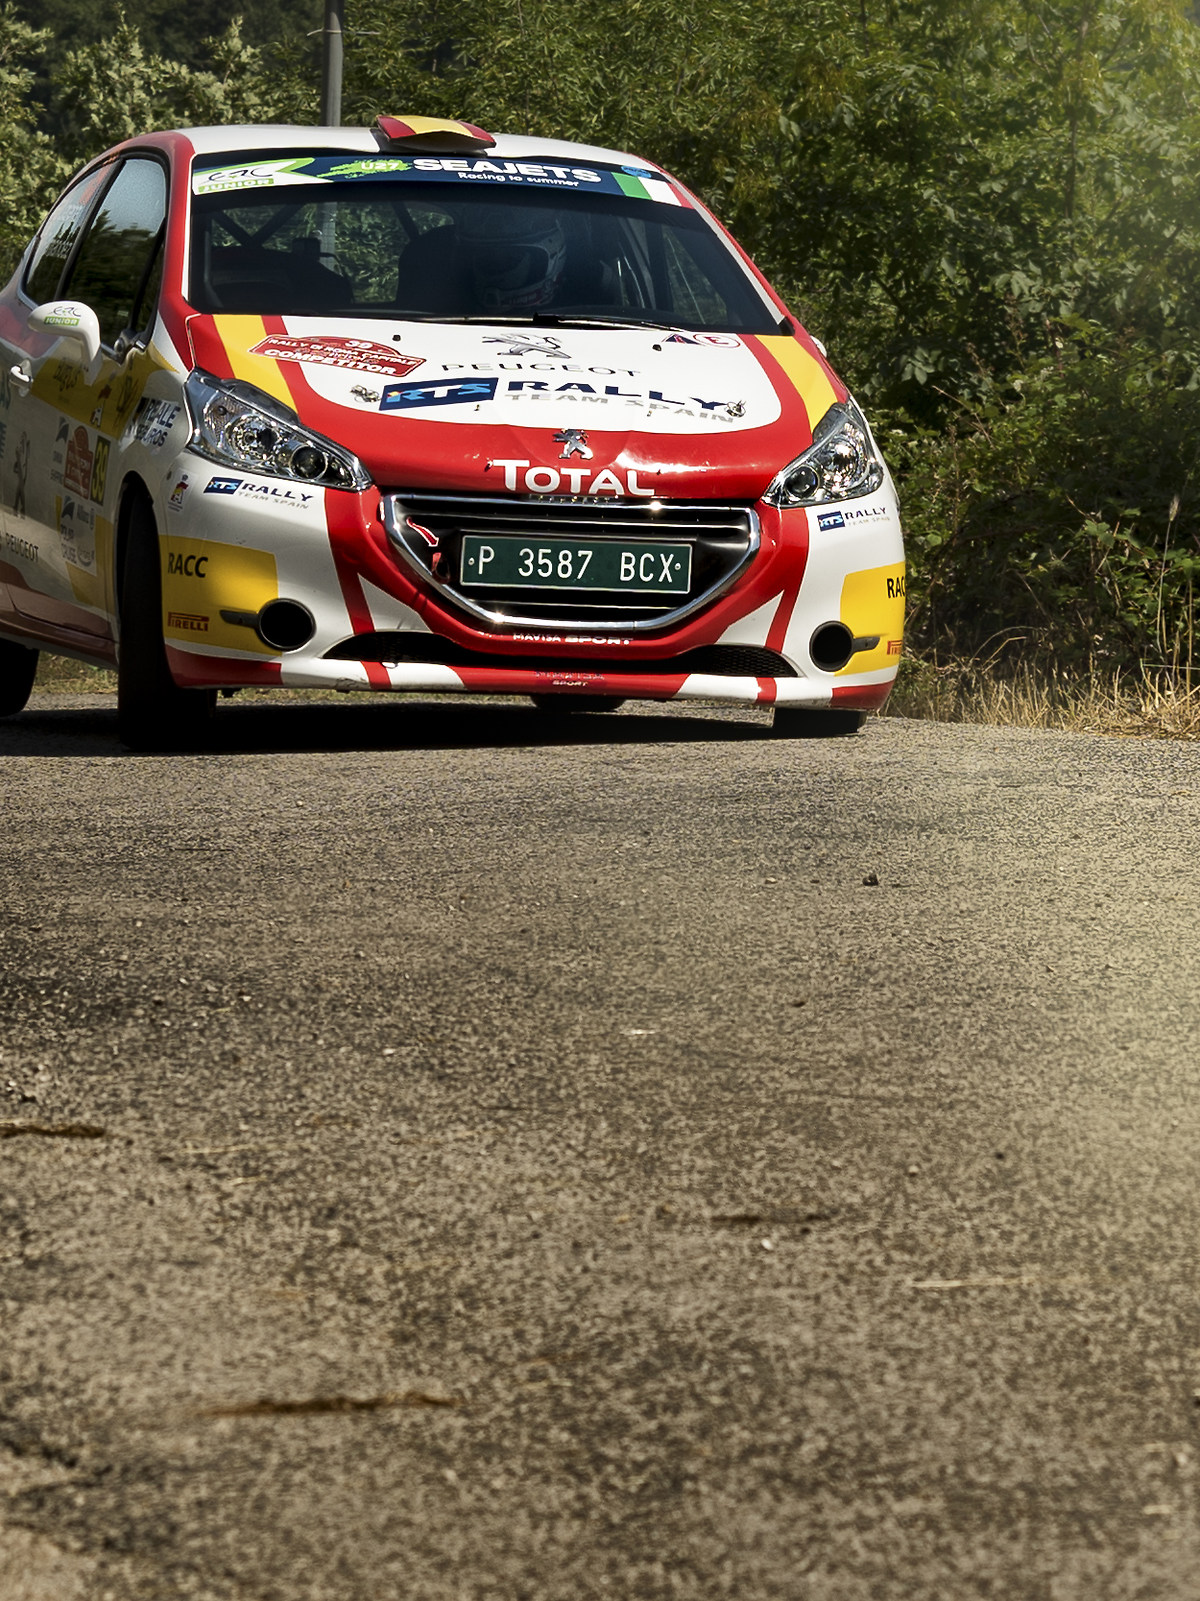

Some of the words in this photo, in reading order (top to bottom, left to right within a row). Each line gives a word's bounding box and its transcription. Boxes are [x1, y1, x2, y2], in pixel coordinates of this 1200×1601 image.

[360, 162, 399, 171] U27
[413, 159, 601, 183] SEAJETS
[201, 178, 273, 193] JUNIOR
[457, 172, 505, 182] Racing
[527, 177, 579, 187] summer
[45, 317, 78, 326] JUNIOR
[269, 338, 309, 348] RALLY
[358, 352, 418, 366] CAPITALE
[345, 340, 373, 350] 39
[264, 349, 397, 375] COMPETITOR
[441, 362, 641, 377] PEUGEOT
[386, 383, 492, 404] RTS
[507, 381, 731, 411] RALLY
[505, 393, 609, 406] TEAM
[624, 400, 734, 424] SPAIN
[91, 441, 109, 502] 39
[492, 459, 655, 496] TOTAL
[238, 491, 269, 501] TEAM
[274, 497, 309, 509] SPAIN
[241, 483, 314, 502] RALLY
[845, 507, 887, 520] RALLY
[6, 532, 39, 563] PEUGEOT
[168, 552, 208, 578] RACC
[478, 545, 495, 575] P
[518, 548, 593, 580] 3587
[619, 552, 675, 583] BCX
[168, 611, 210, 632] PIRELLI
